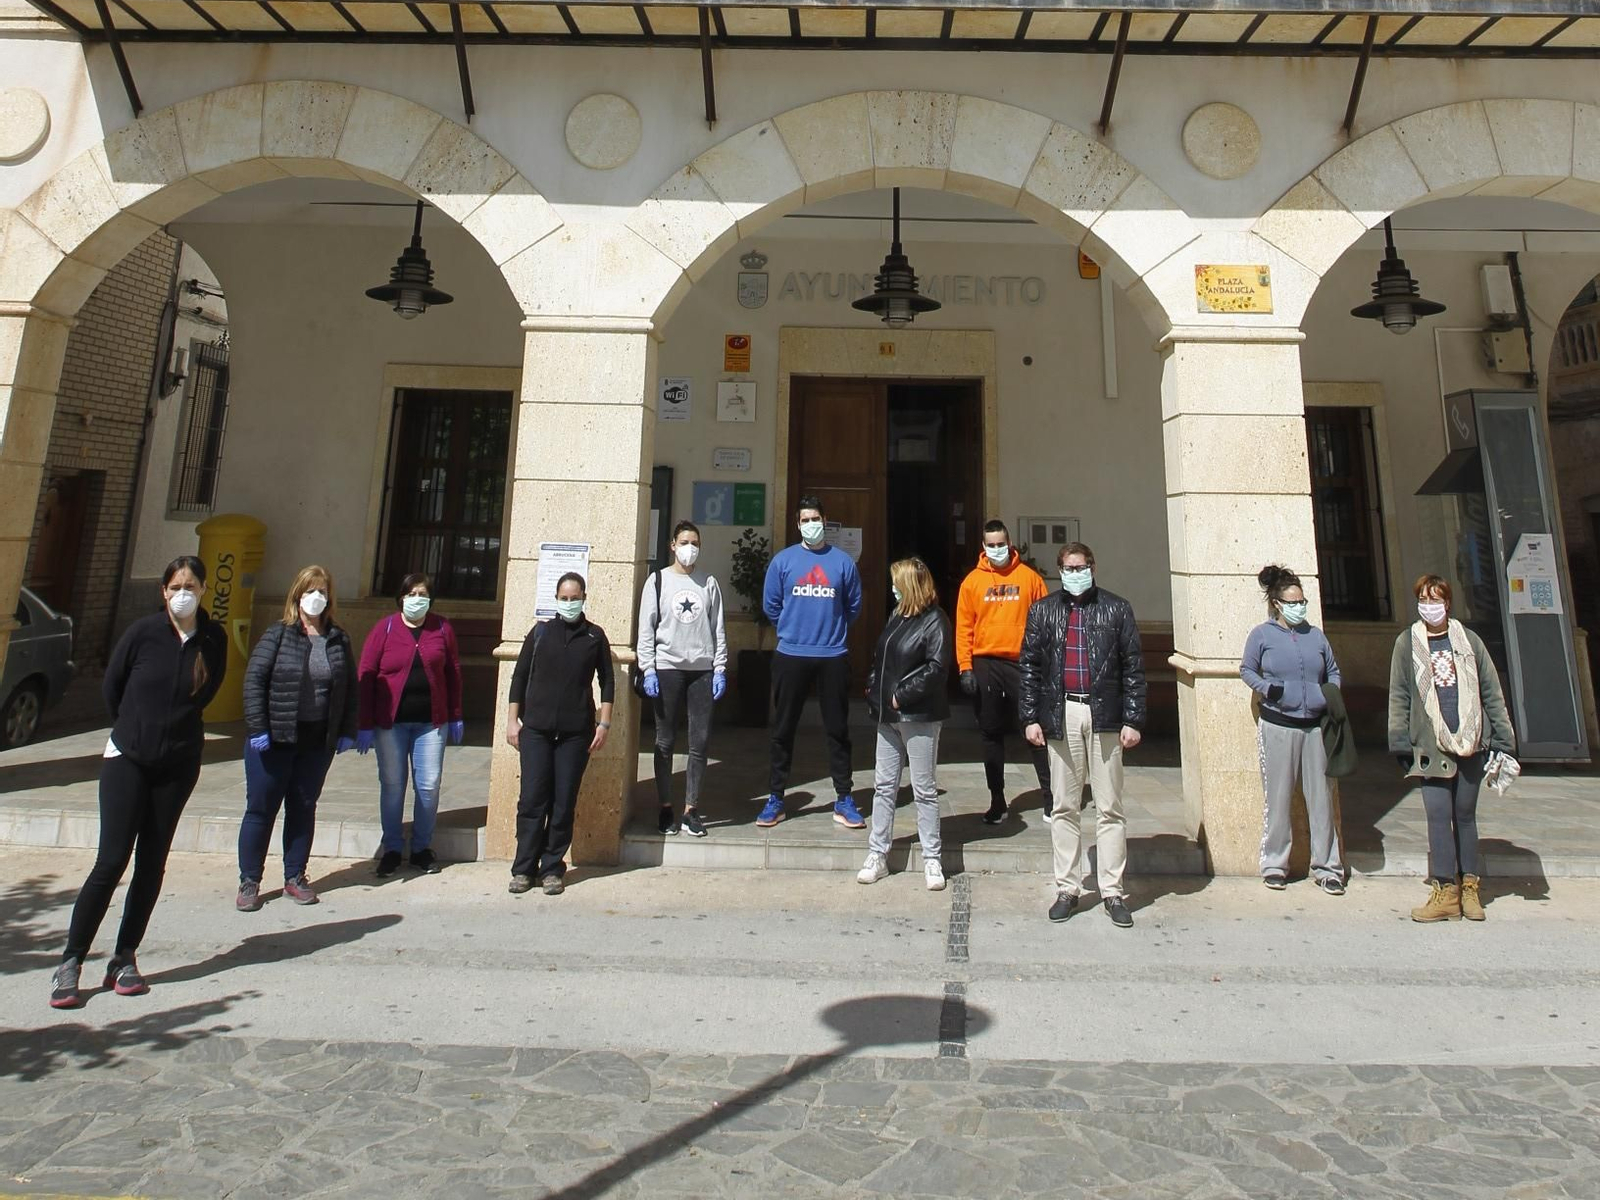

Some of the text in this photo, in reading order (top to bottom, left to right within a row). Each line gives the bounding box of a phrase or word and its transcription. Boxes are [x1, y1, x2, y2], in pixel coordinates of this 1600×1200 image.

[778, 272, 1047, 307] AYUNMIENTO
[211, 552, 235, 625] RREOS
[792, 584, 836, 598] adidas
